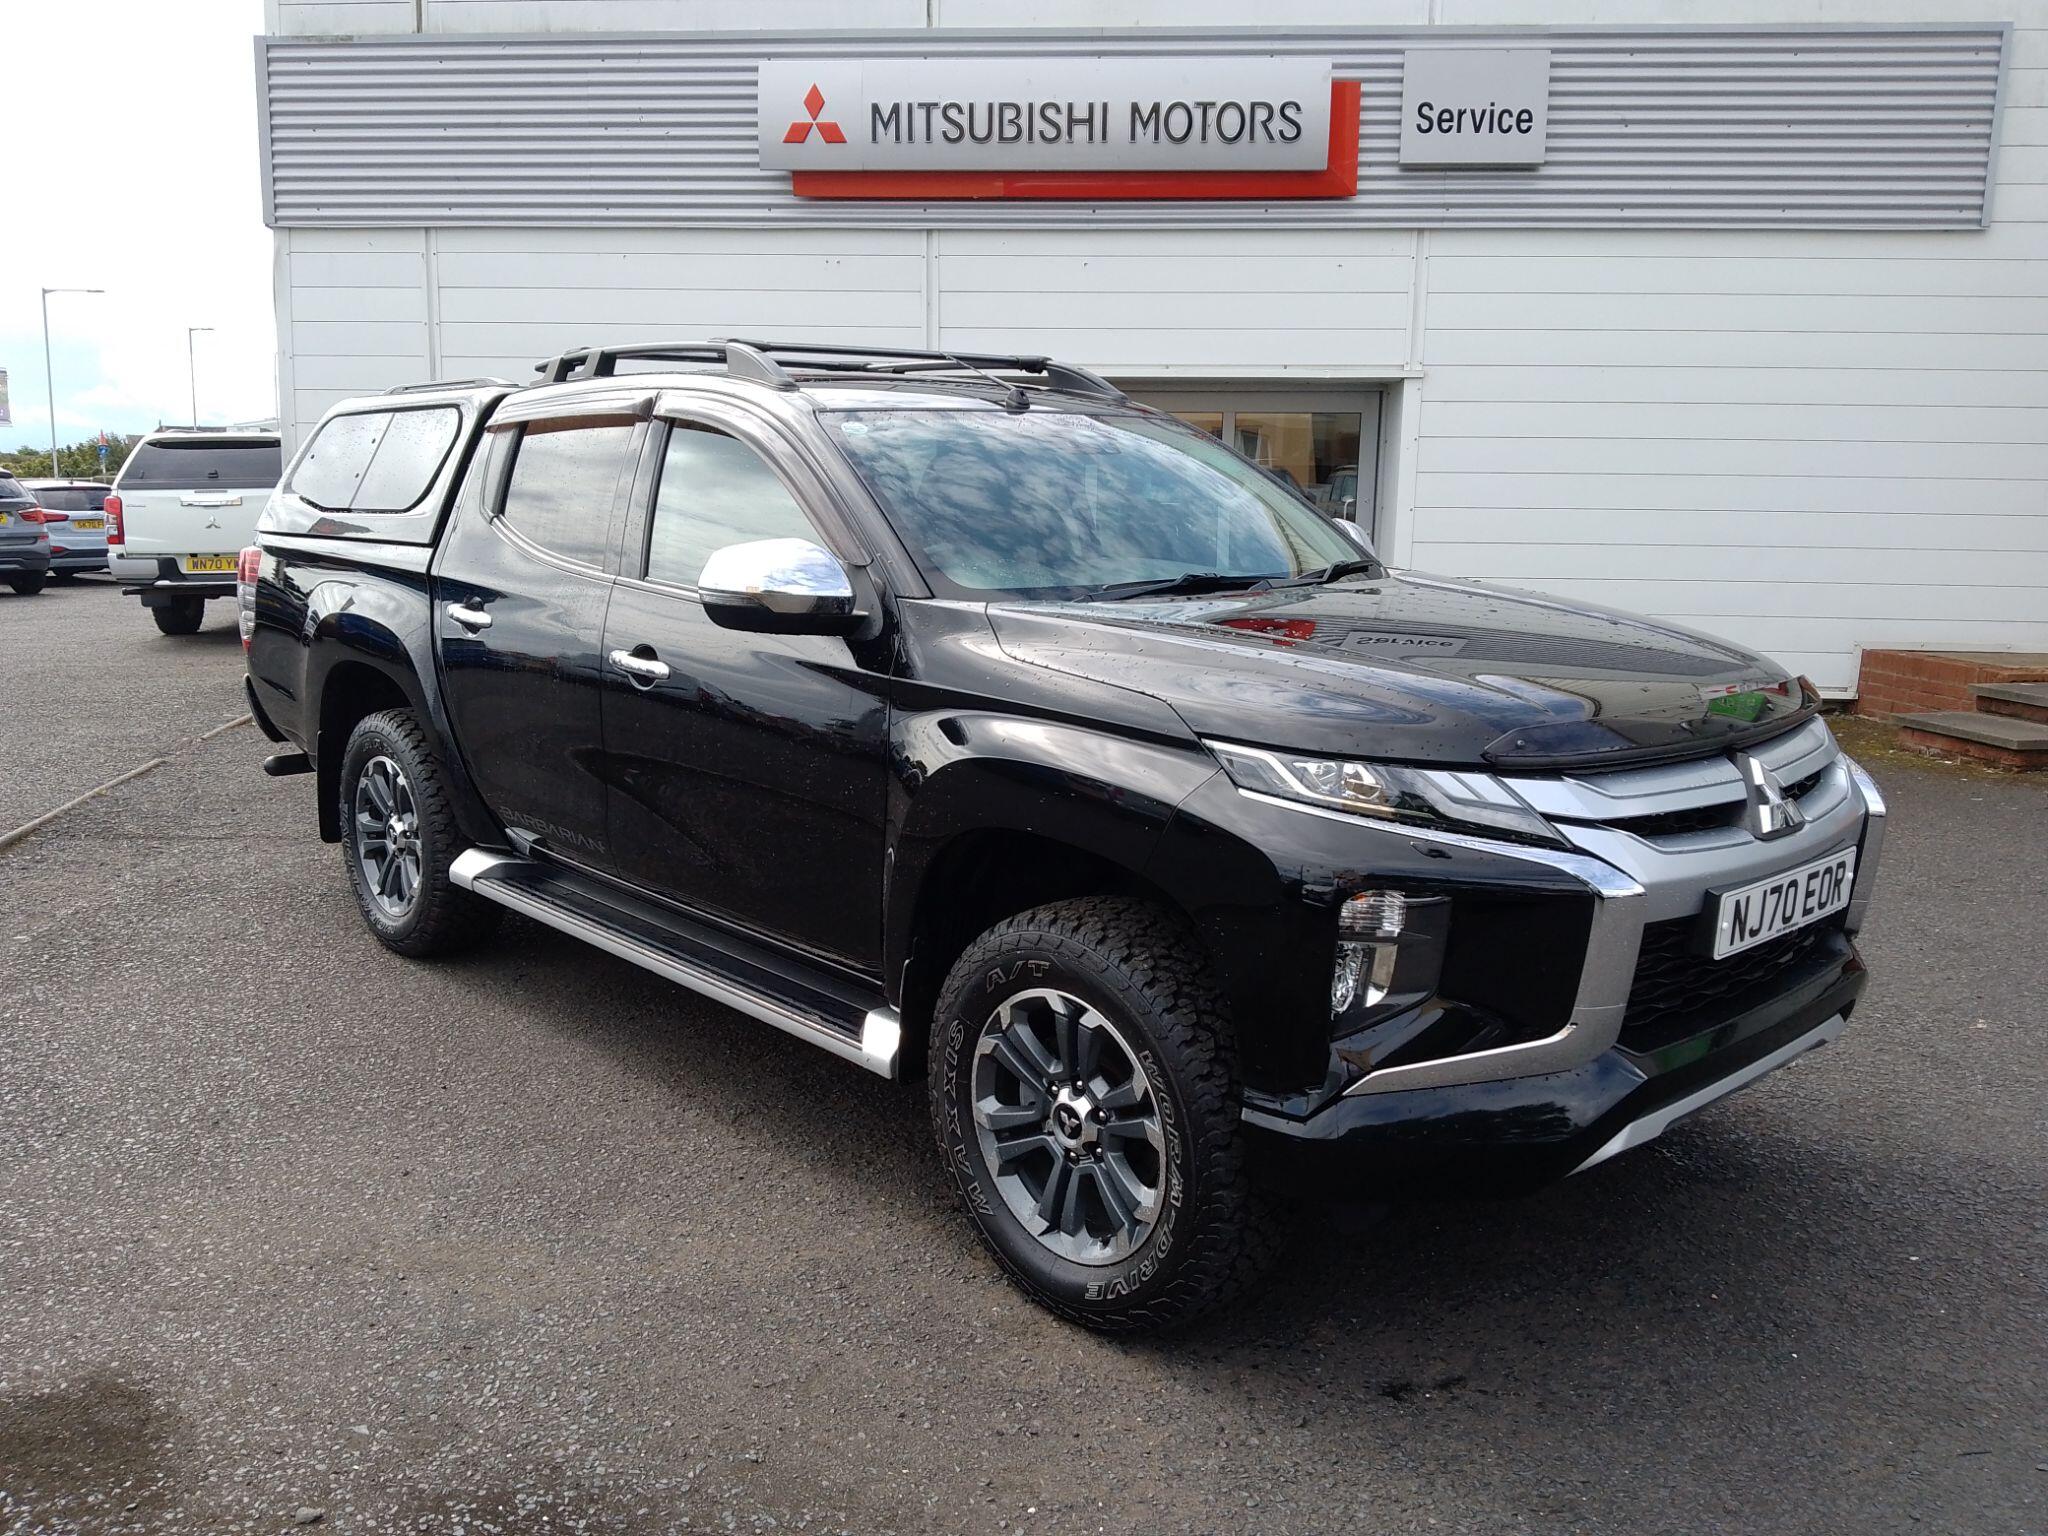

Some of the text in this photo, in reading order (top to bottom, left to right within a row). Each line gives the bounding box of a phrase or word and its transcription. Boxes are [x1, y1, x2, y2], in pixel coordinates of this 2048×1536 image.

[870, 101, 1303, 144] MITSUBISHI MOTORS
[1416, 101, 1533, 134] Service
[192, 559, 222, 570] WN70
[500, 805, 606, 854] BARBARIAN
[1729, 860, 1847, 947] NJ70 EOR
[986, 960, 1051, 993] A/T
[944, 1019, 997, 1216] MAXXIS
[1085, 1050, 1182, 1300] WORM-DRIVE
